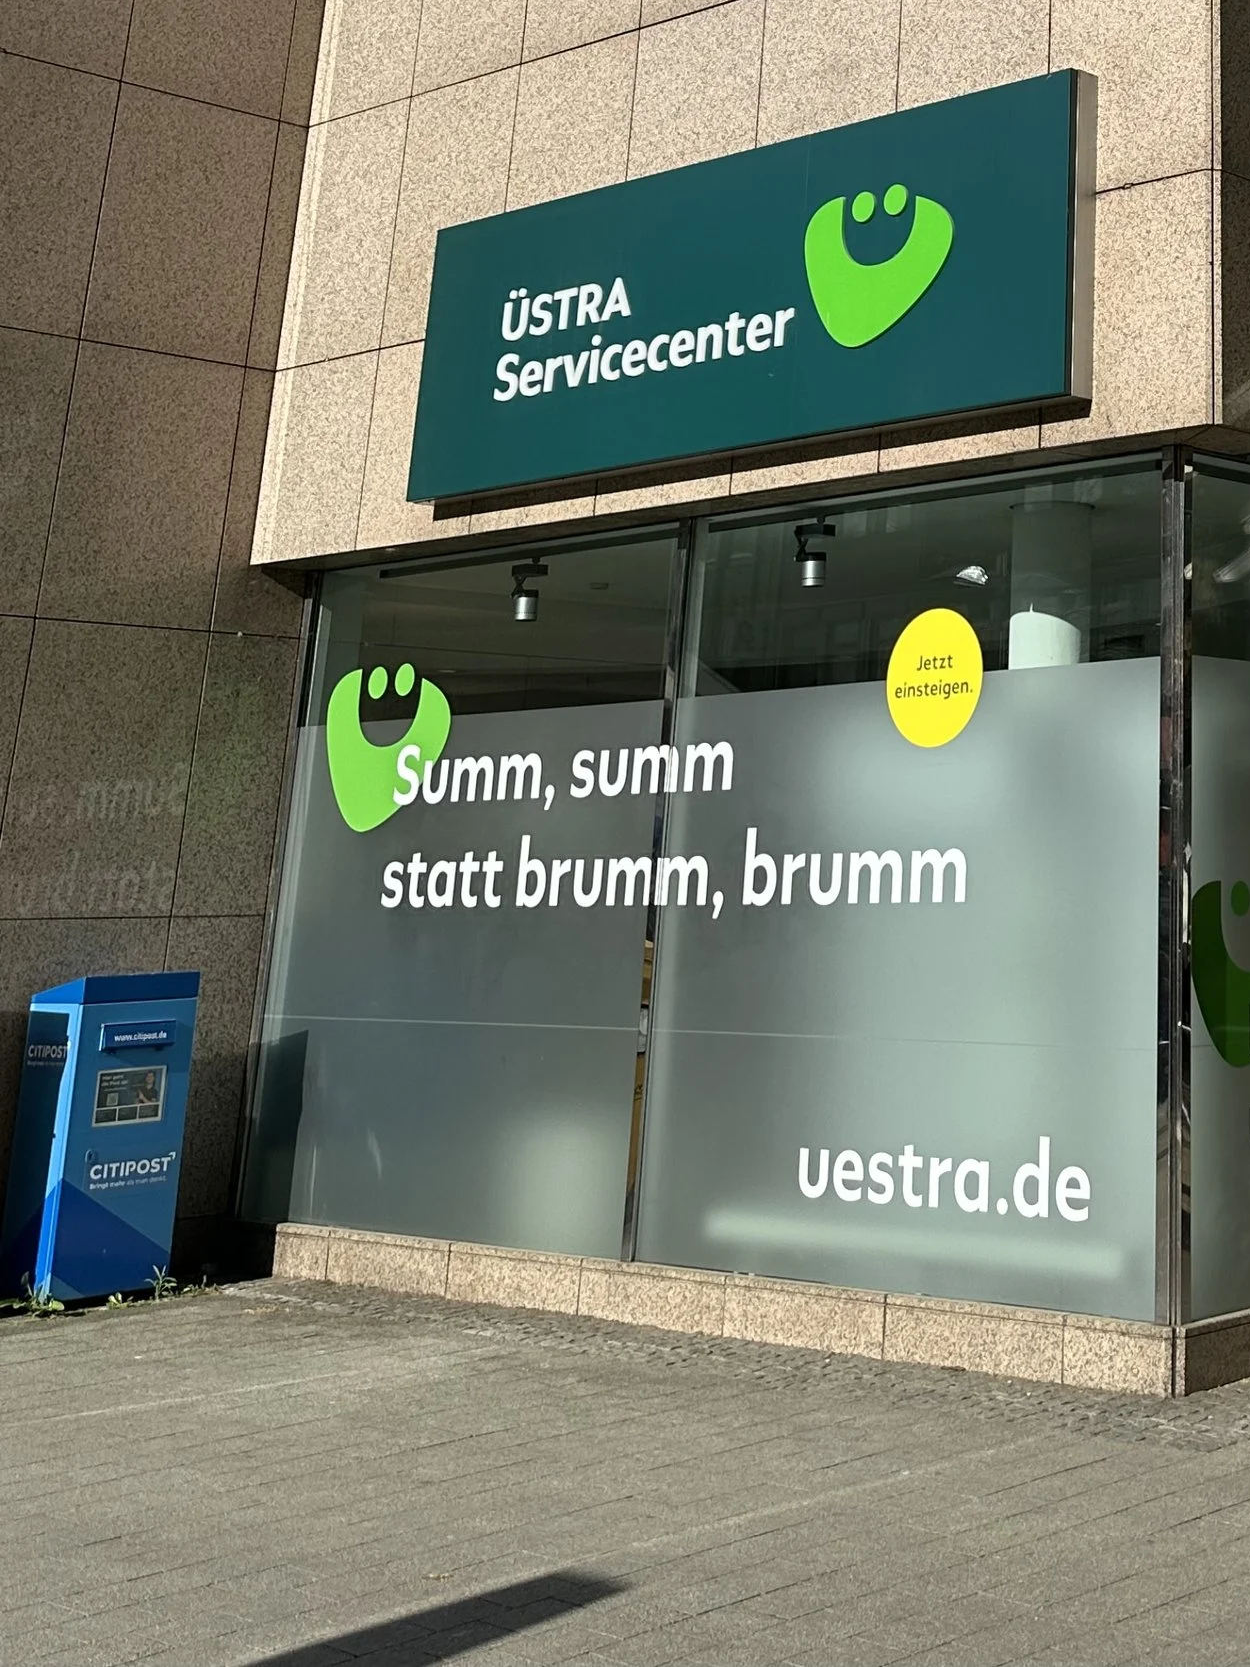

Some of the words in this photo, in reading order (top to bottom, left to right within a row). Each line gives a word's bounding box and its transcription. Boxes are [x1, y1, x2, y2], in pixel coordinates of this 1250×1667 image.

[501, 277, 631, 341] ÜSTRA
[493, 306, 795, 402] Servicecenter
[894, 679, 973, 700] einsteigen.
[916, 655, 953, 672] Jetzt
[392, 744, 556, 811] Summ,
[569, 739, 734, 799] summ
[380, 848, 502, 910] statt
[515, 834, 725, 920] brumm,
[741, 827, 967, 907] brumm
[28, 1044, 67, 1059] CITIPOST
[90, 1156, 172, 1180] CITIPOST
[797, 1135, 1092, 1223] uestra.de
